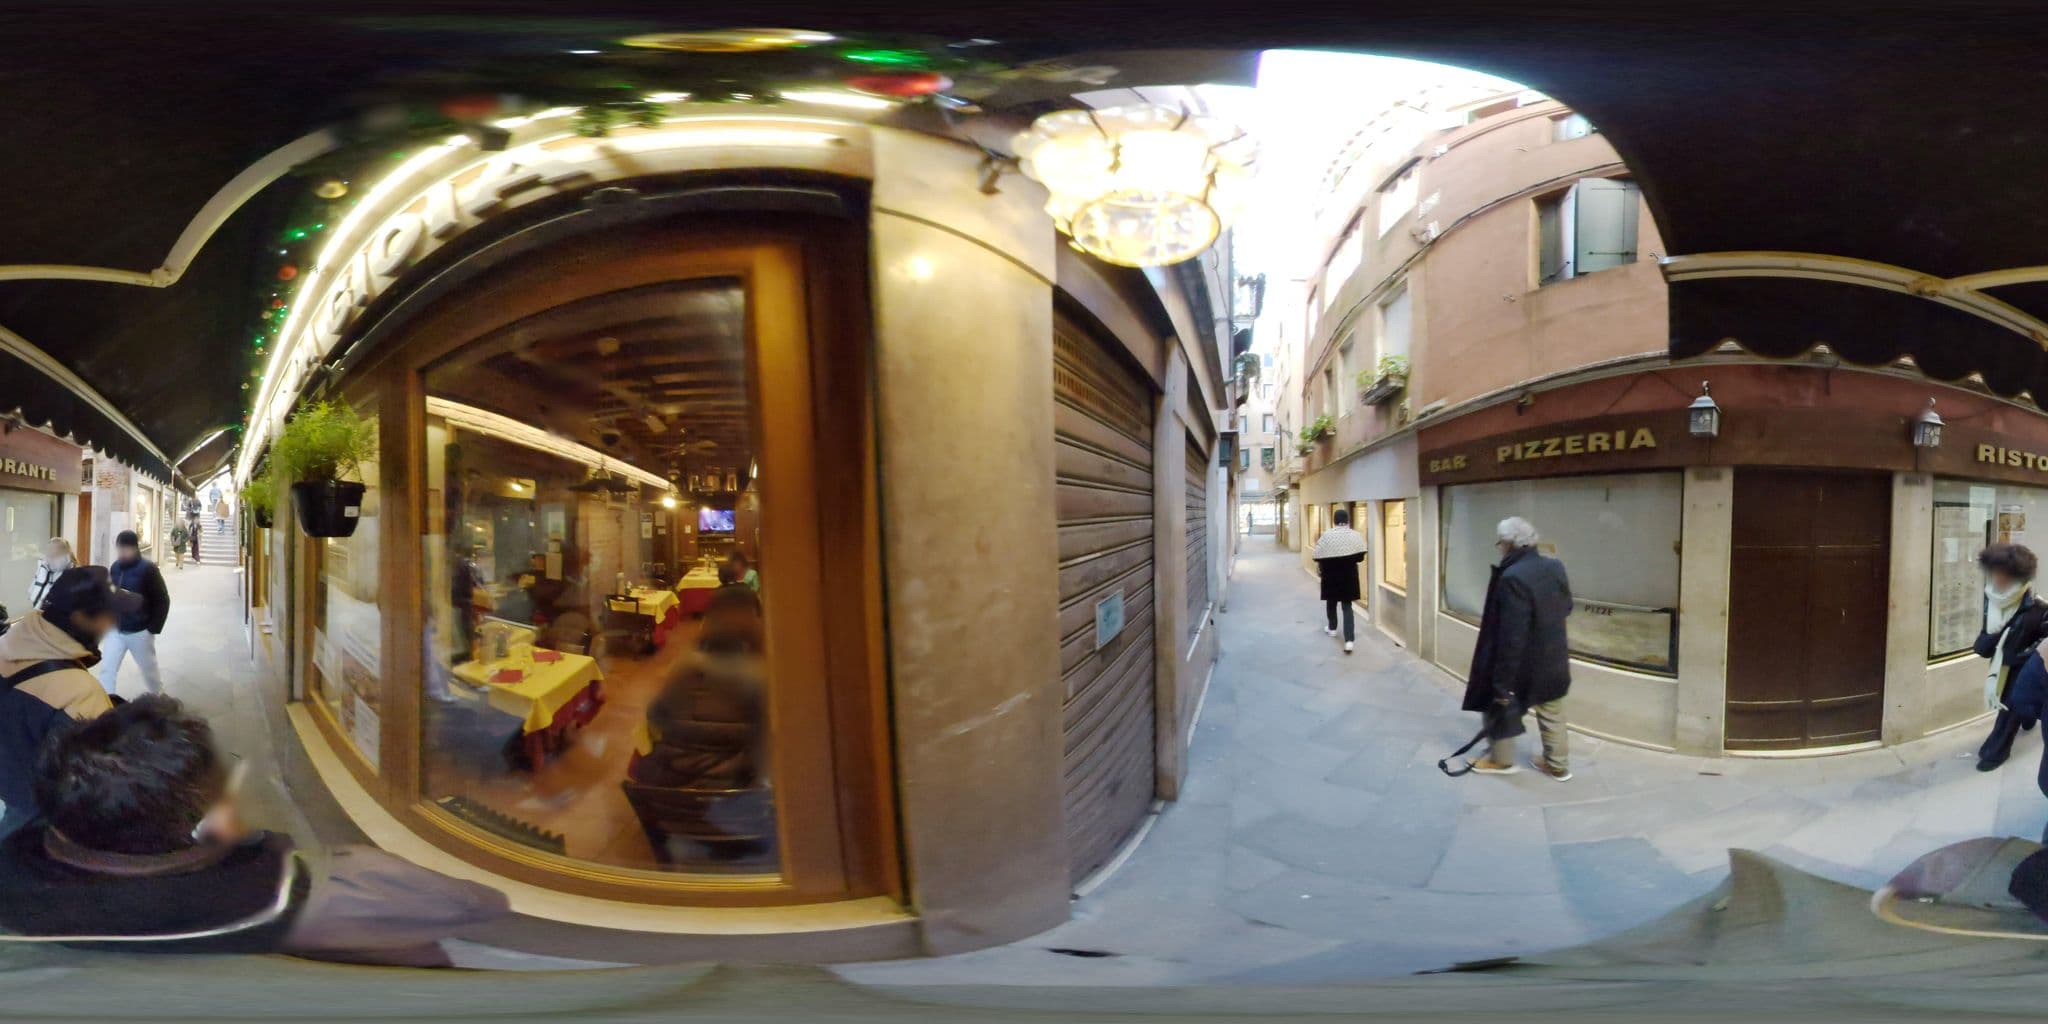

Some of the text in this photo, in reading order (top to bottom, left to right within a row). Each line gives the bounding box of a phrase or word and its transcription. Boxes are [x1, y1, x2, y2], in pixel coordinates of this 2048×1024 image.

[1429, 427, 1657, 473] BAR PIZZERIA
[1977, 443, 2048, 472] RISTO
[0, 457, 57, 480] RANTE
